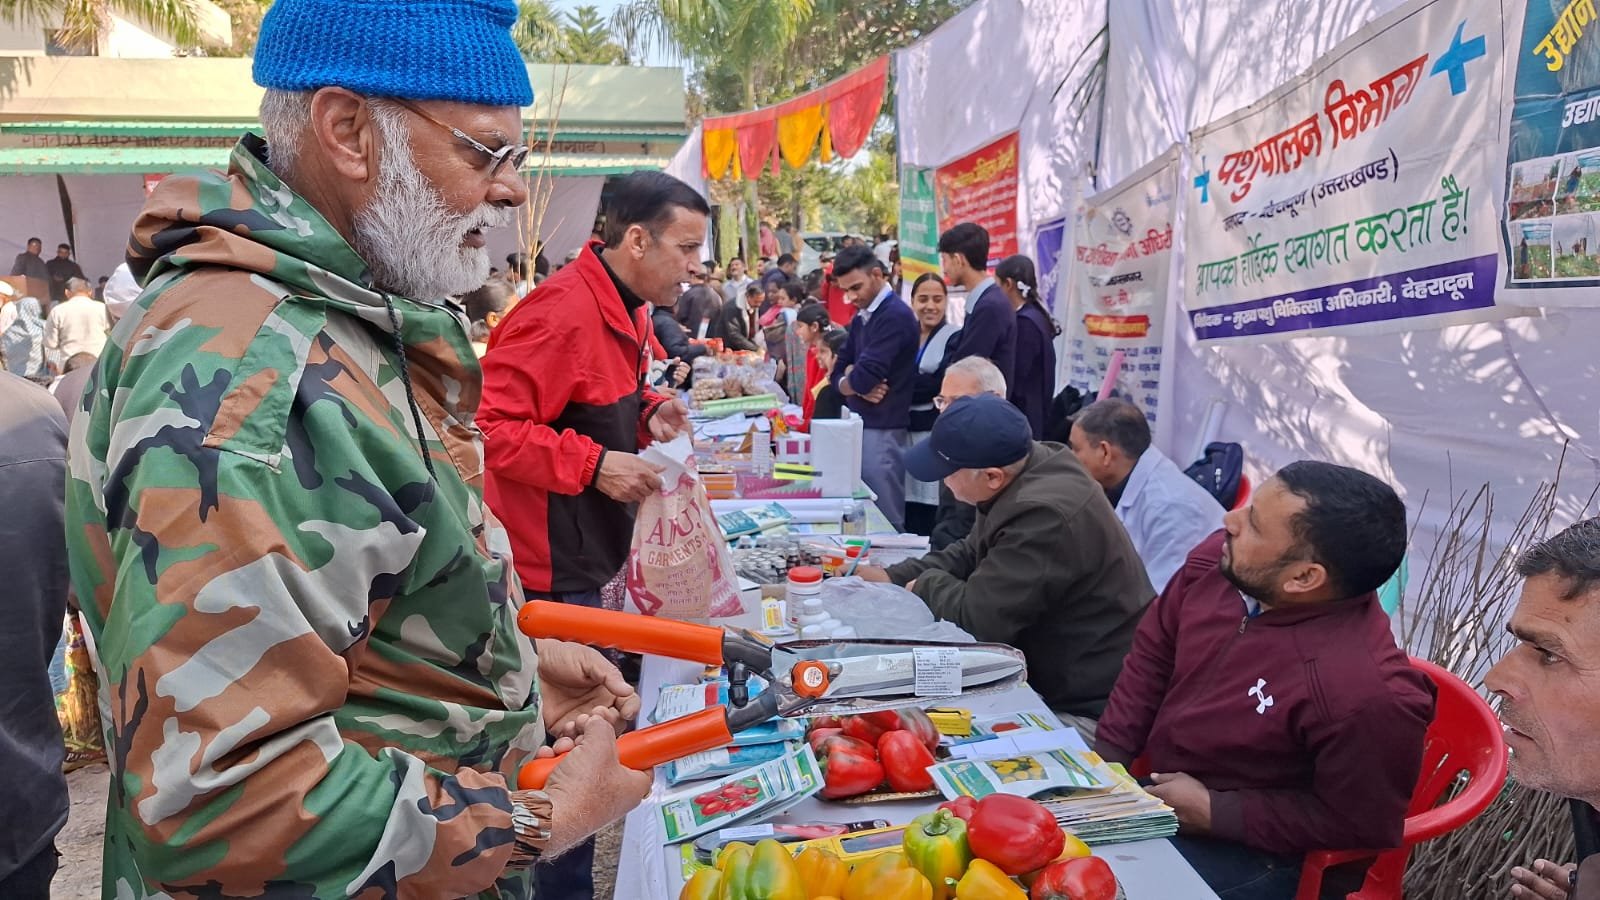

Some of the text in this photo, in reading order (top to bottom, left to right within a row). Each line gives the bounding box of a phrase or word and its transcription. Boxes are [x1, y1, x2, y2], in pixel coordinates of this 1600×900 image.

[1218, 53, 1429, 203] पशुपालन विभाग
[1562, 95, 1600, 128] उद्या
[1311, 147, 1399, 208] (उत्तराखण्ड)
[1284, 222, 1350, 274] स्वागत
[1354, 199, 1438, 255] करता
[1272, 297, 1323, 319] चिकित्सा
[1401, 272, 1474, 300] देहरादून
